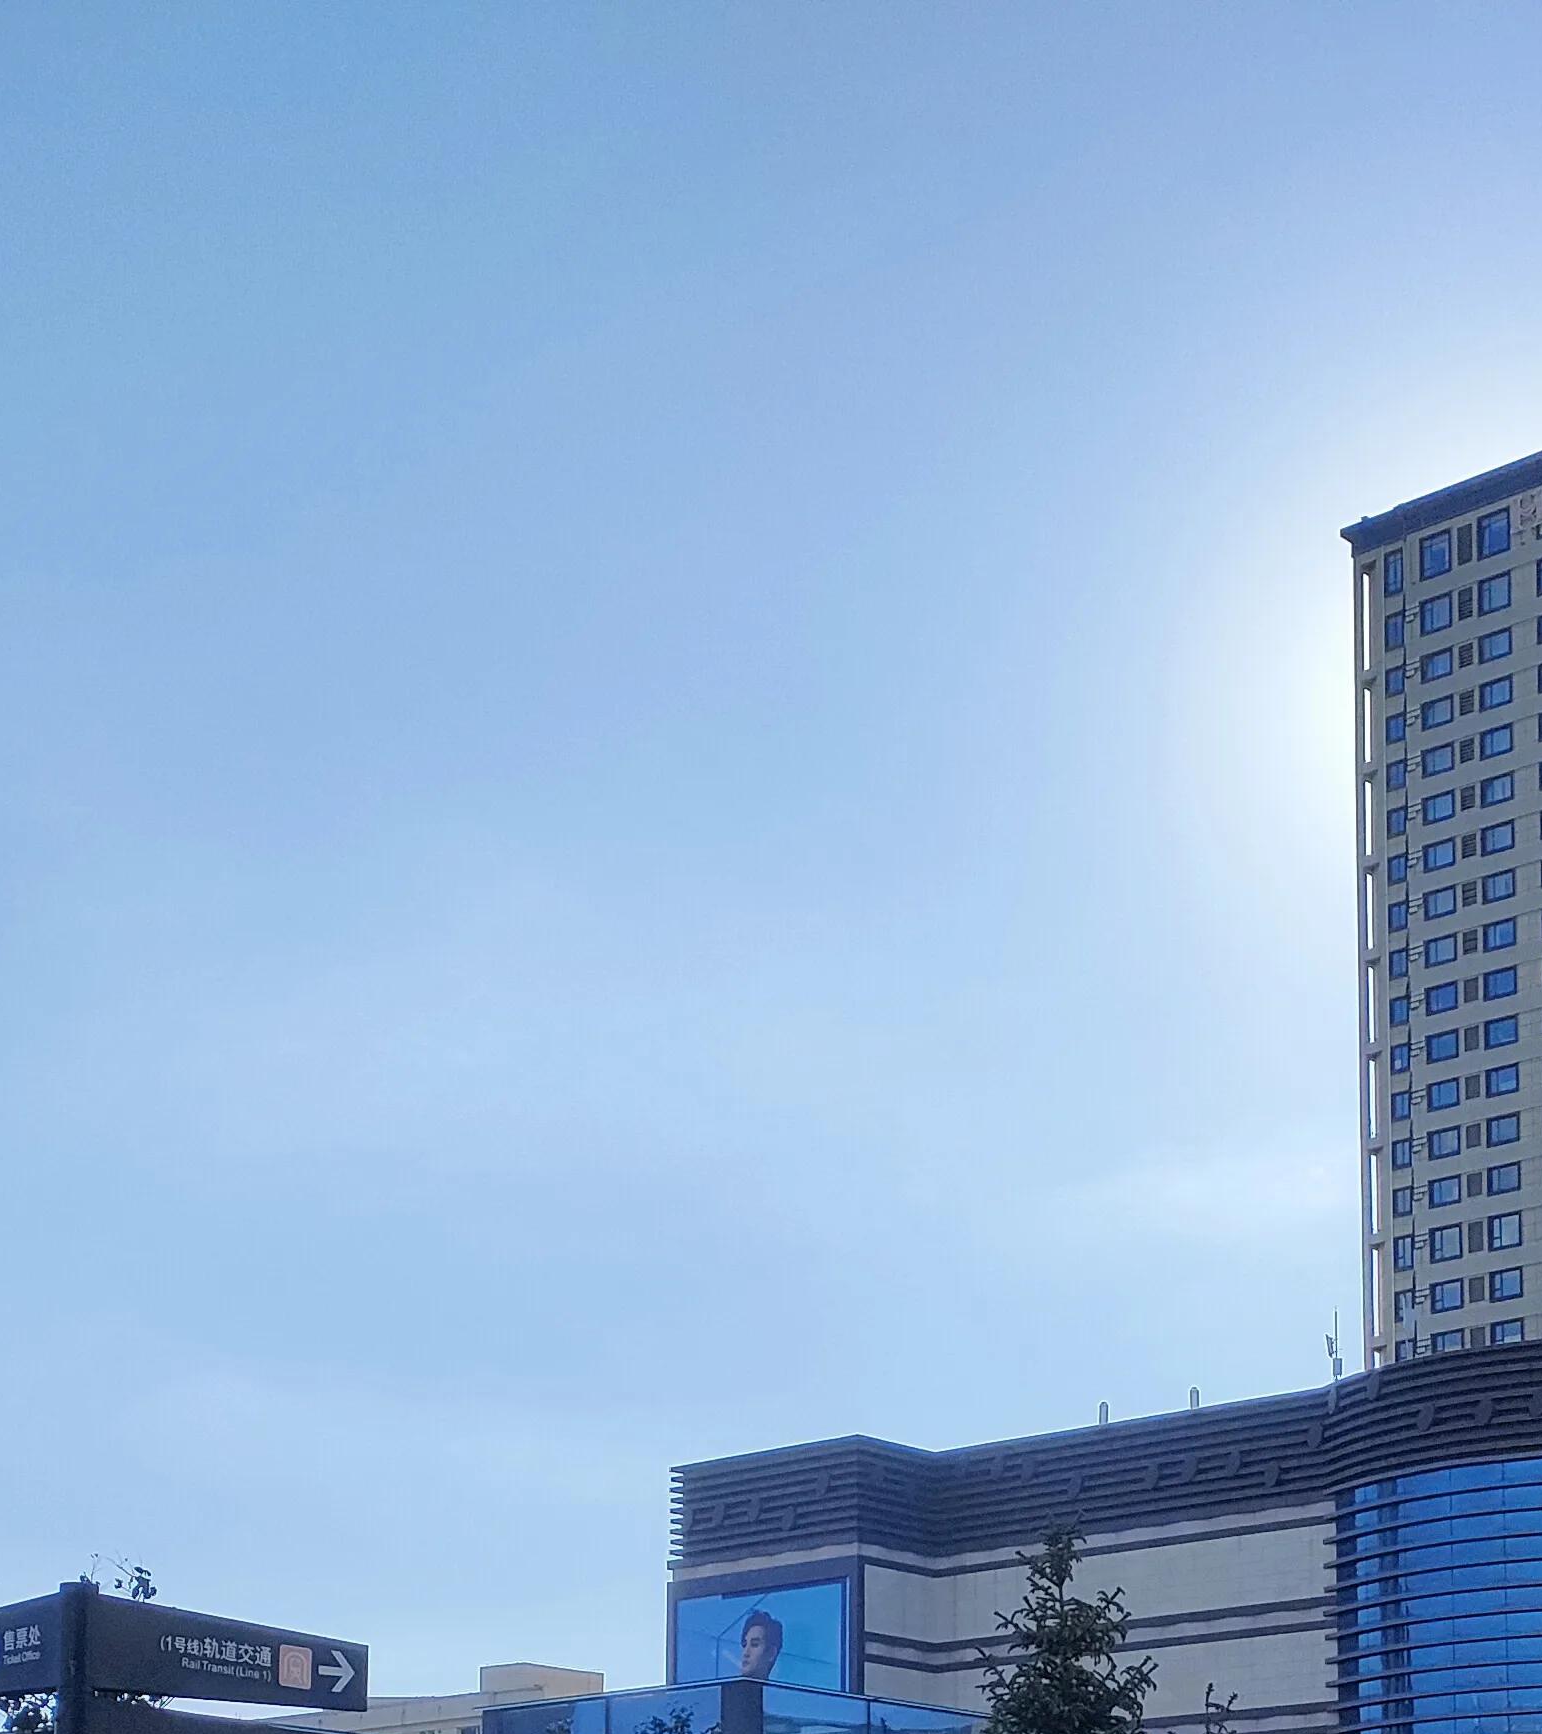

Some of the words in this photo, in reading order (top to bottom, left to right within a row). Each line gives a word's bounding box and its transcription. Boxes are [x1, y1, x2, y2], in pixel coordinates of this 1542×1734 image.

[3, 1624, 41, 1651] 售票处
[160, 1635, 272, 1667] (1号线)轨道交通
[181, 1657, 200, 1670] Rail
